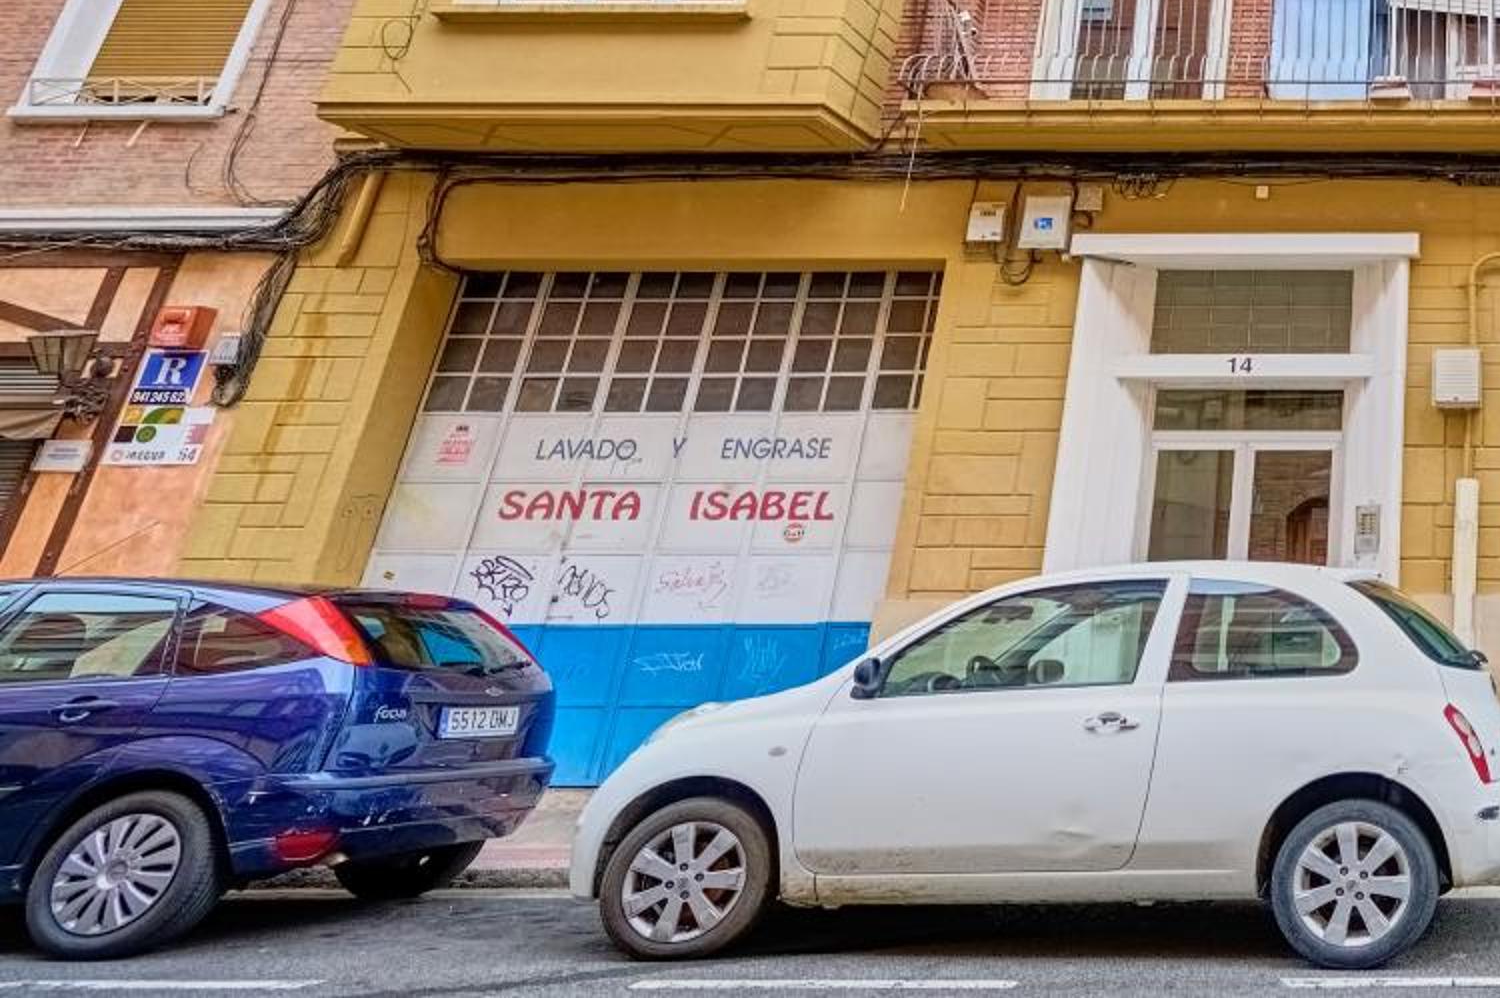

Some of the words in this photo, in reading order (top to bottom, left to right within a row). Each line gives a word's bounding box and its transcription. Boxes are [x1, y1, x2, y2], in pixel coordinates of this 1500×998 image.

[152, 357, 187, 385] R
[1226, 357, 1252, 373] 14
[536, 439, 637, 461] LAVADO
[672, 437, 687, 459] Y
[720, 437, 832, 459] ENGRASE
[498, 490, 641, 521] SANTA
[689, 490, 835, 521] ISABEL
[451, 711, 486, 730] 5512
[489, 710, 517, 729] DMJ
